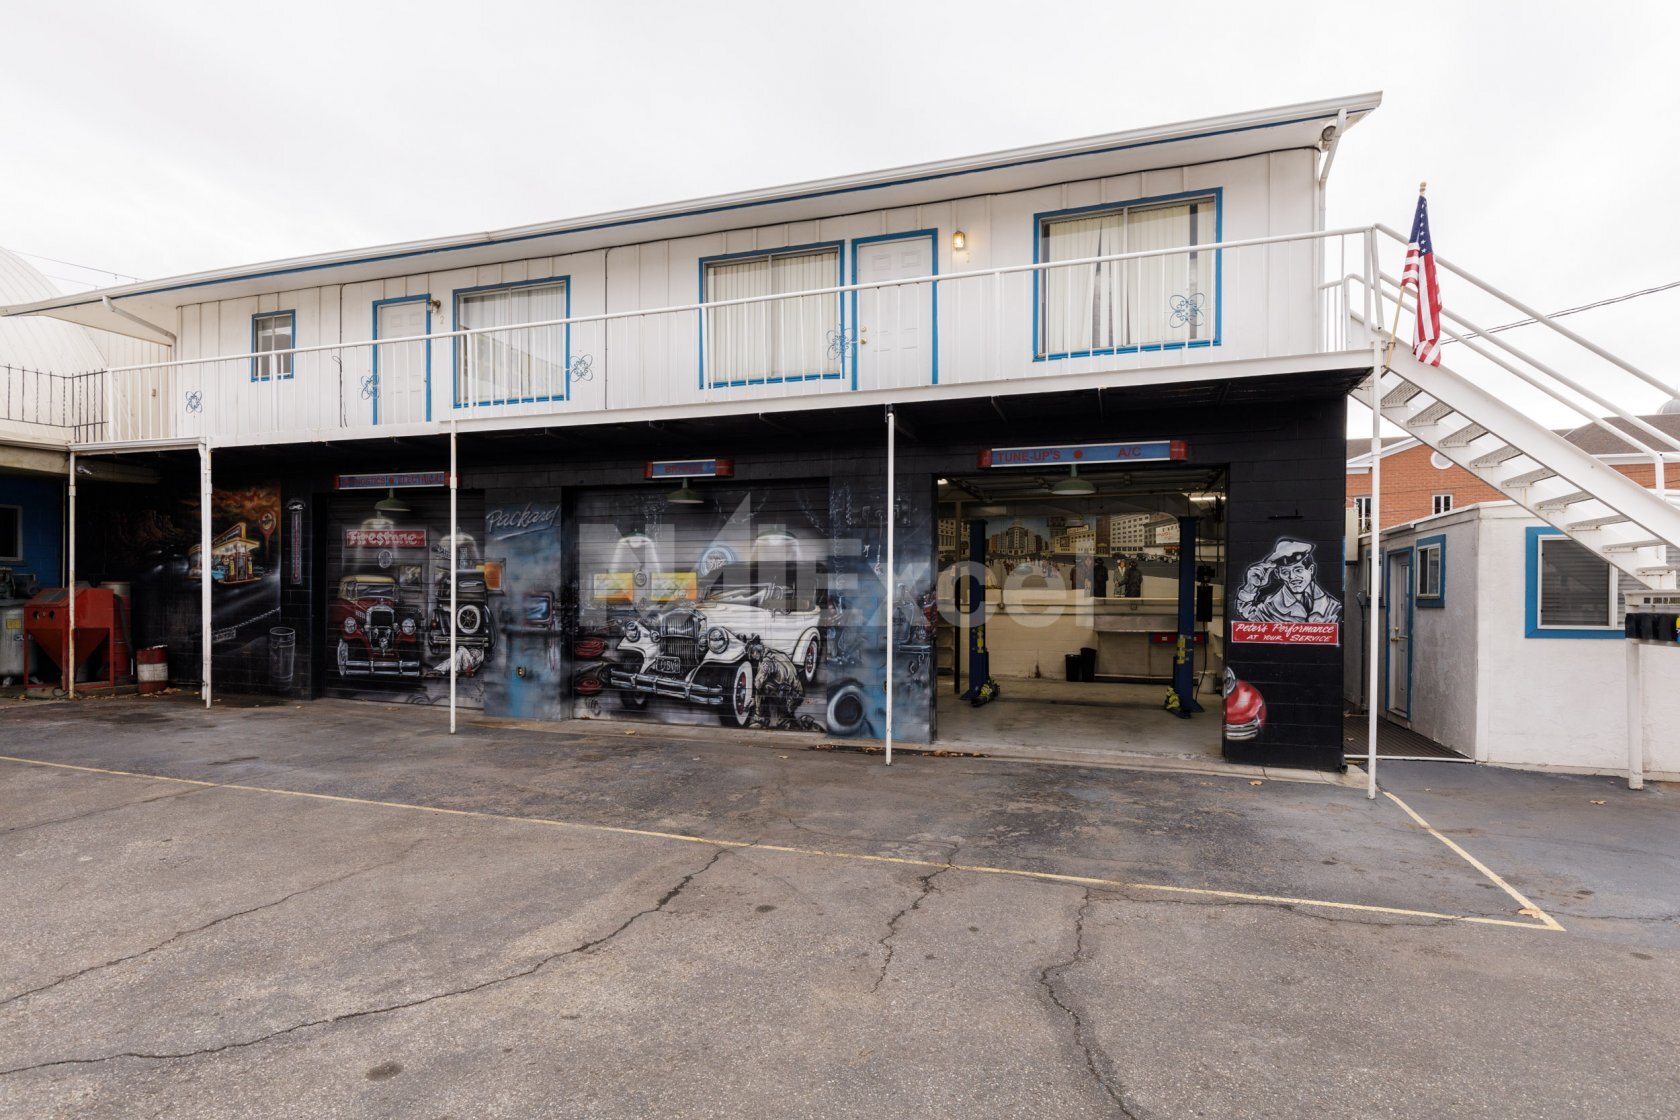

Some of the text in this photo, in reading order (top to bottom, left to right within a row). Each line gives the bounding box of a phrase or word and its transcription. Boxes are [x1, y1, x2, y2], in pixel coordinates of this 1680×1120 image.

[997, 447, 1142, 463] TUNE-UP'S A/C
[486, 502, 560, 532] Packard
[347, 530, 417, 545] Firestone
[1235, 623, 1335, 638] Peter's Performance
[1290, 634, 1332, 642] SERVICE
